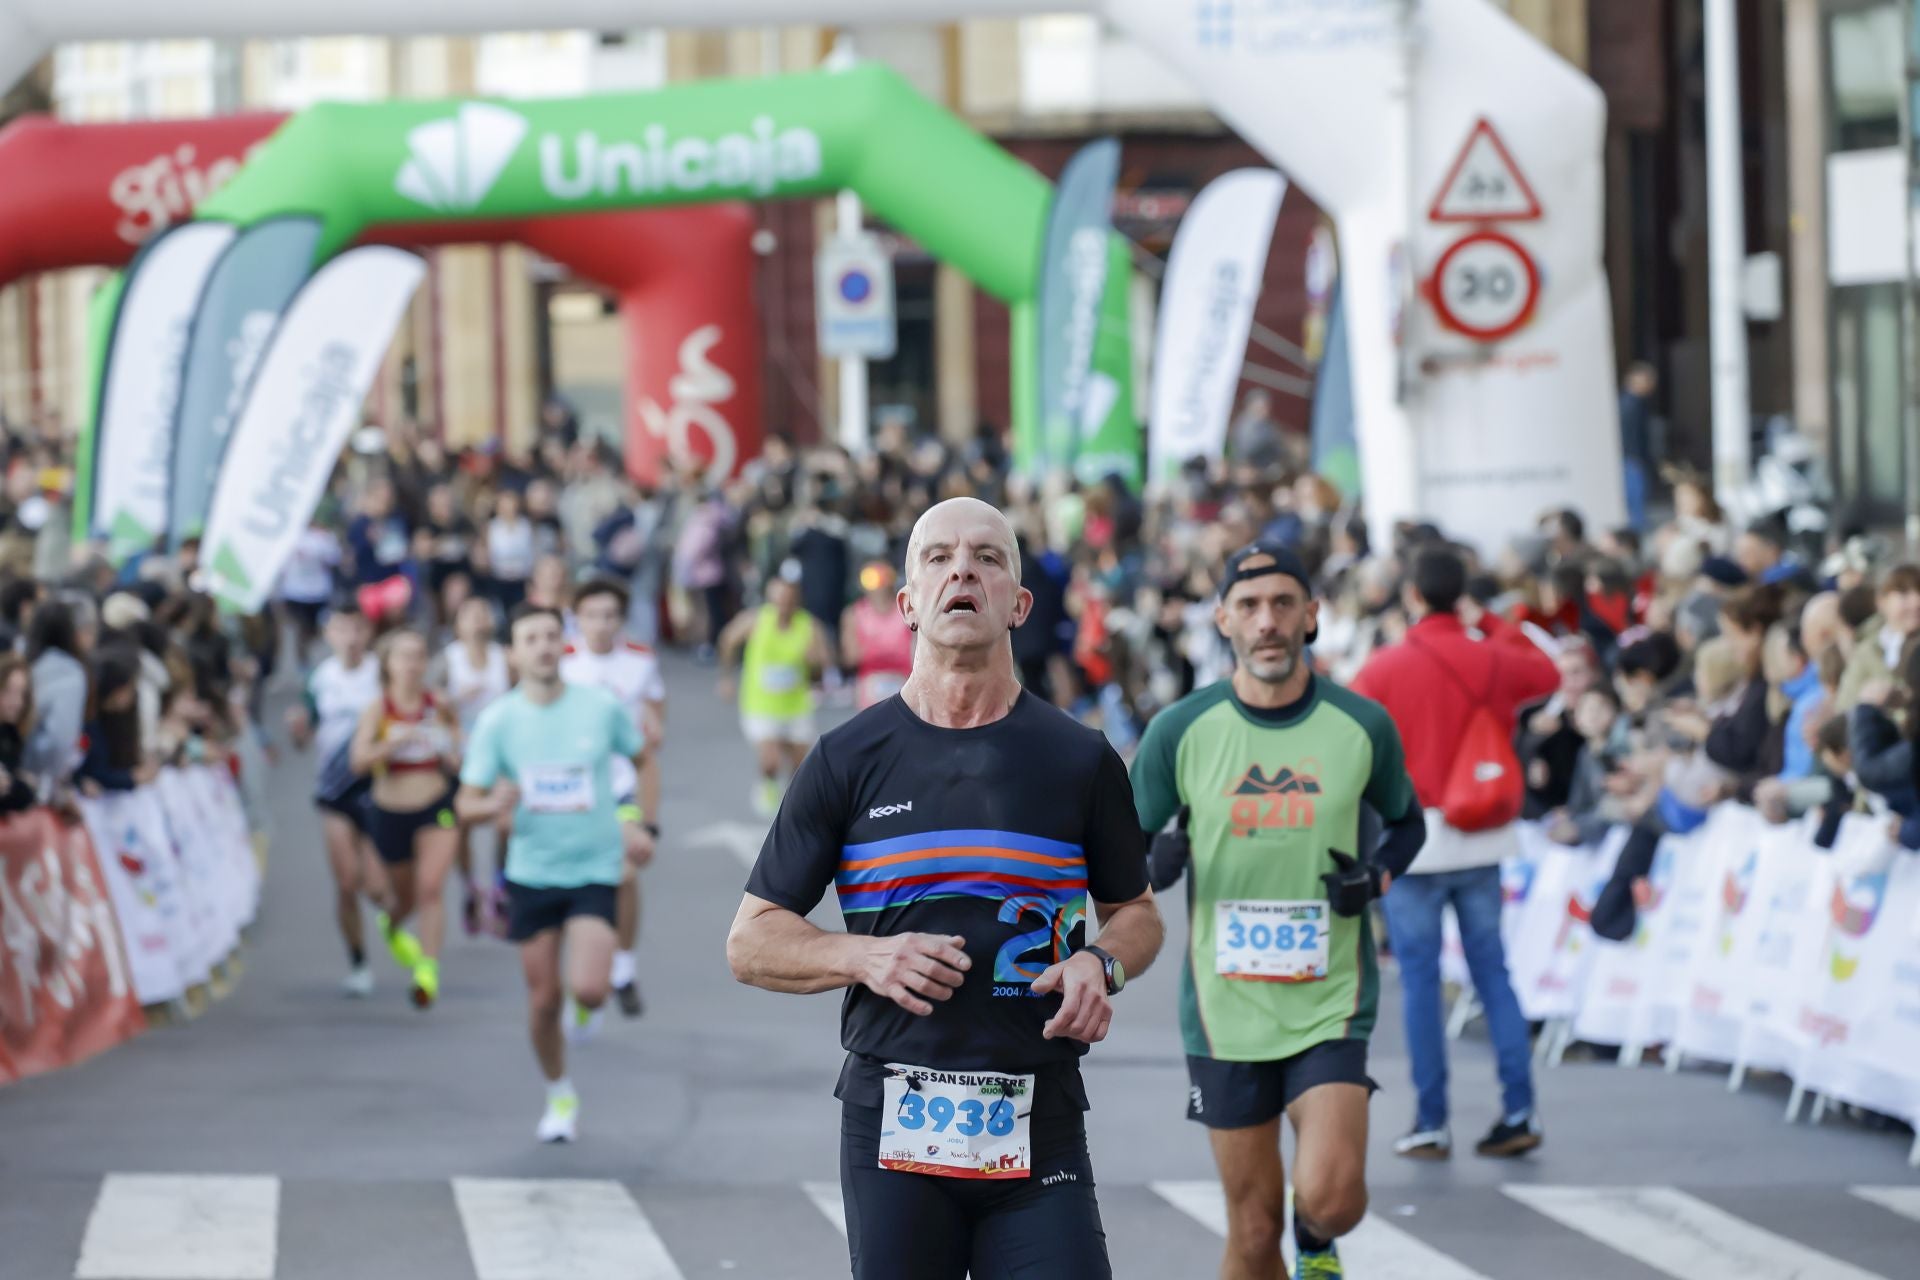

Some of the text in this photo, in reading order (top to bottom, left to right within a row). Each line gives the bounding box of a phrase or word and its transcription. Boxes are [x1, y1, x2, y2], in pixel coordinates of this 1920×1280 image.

[538, 114, 823, 200] Unicaja
[1457, 265, 1516, 304] 30
[240, 338, 362, 540] Unicaja
[1227, 922, 1318, 950] 3082
[912, 1071, 1027, 1088] 55 SAN SILVESTRE
[897, 1093, 1015, 1137] 3938
